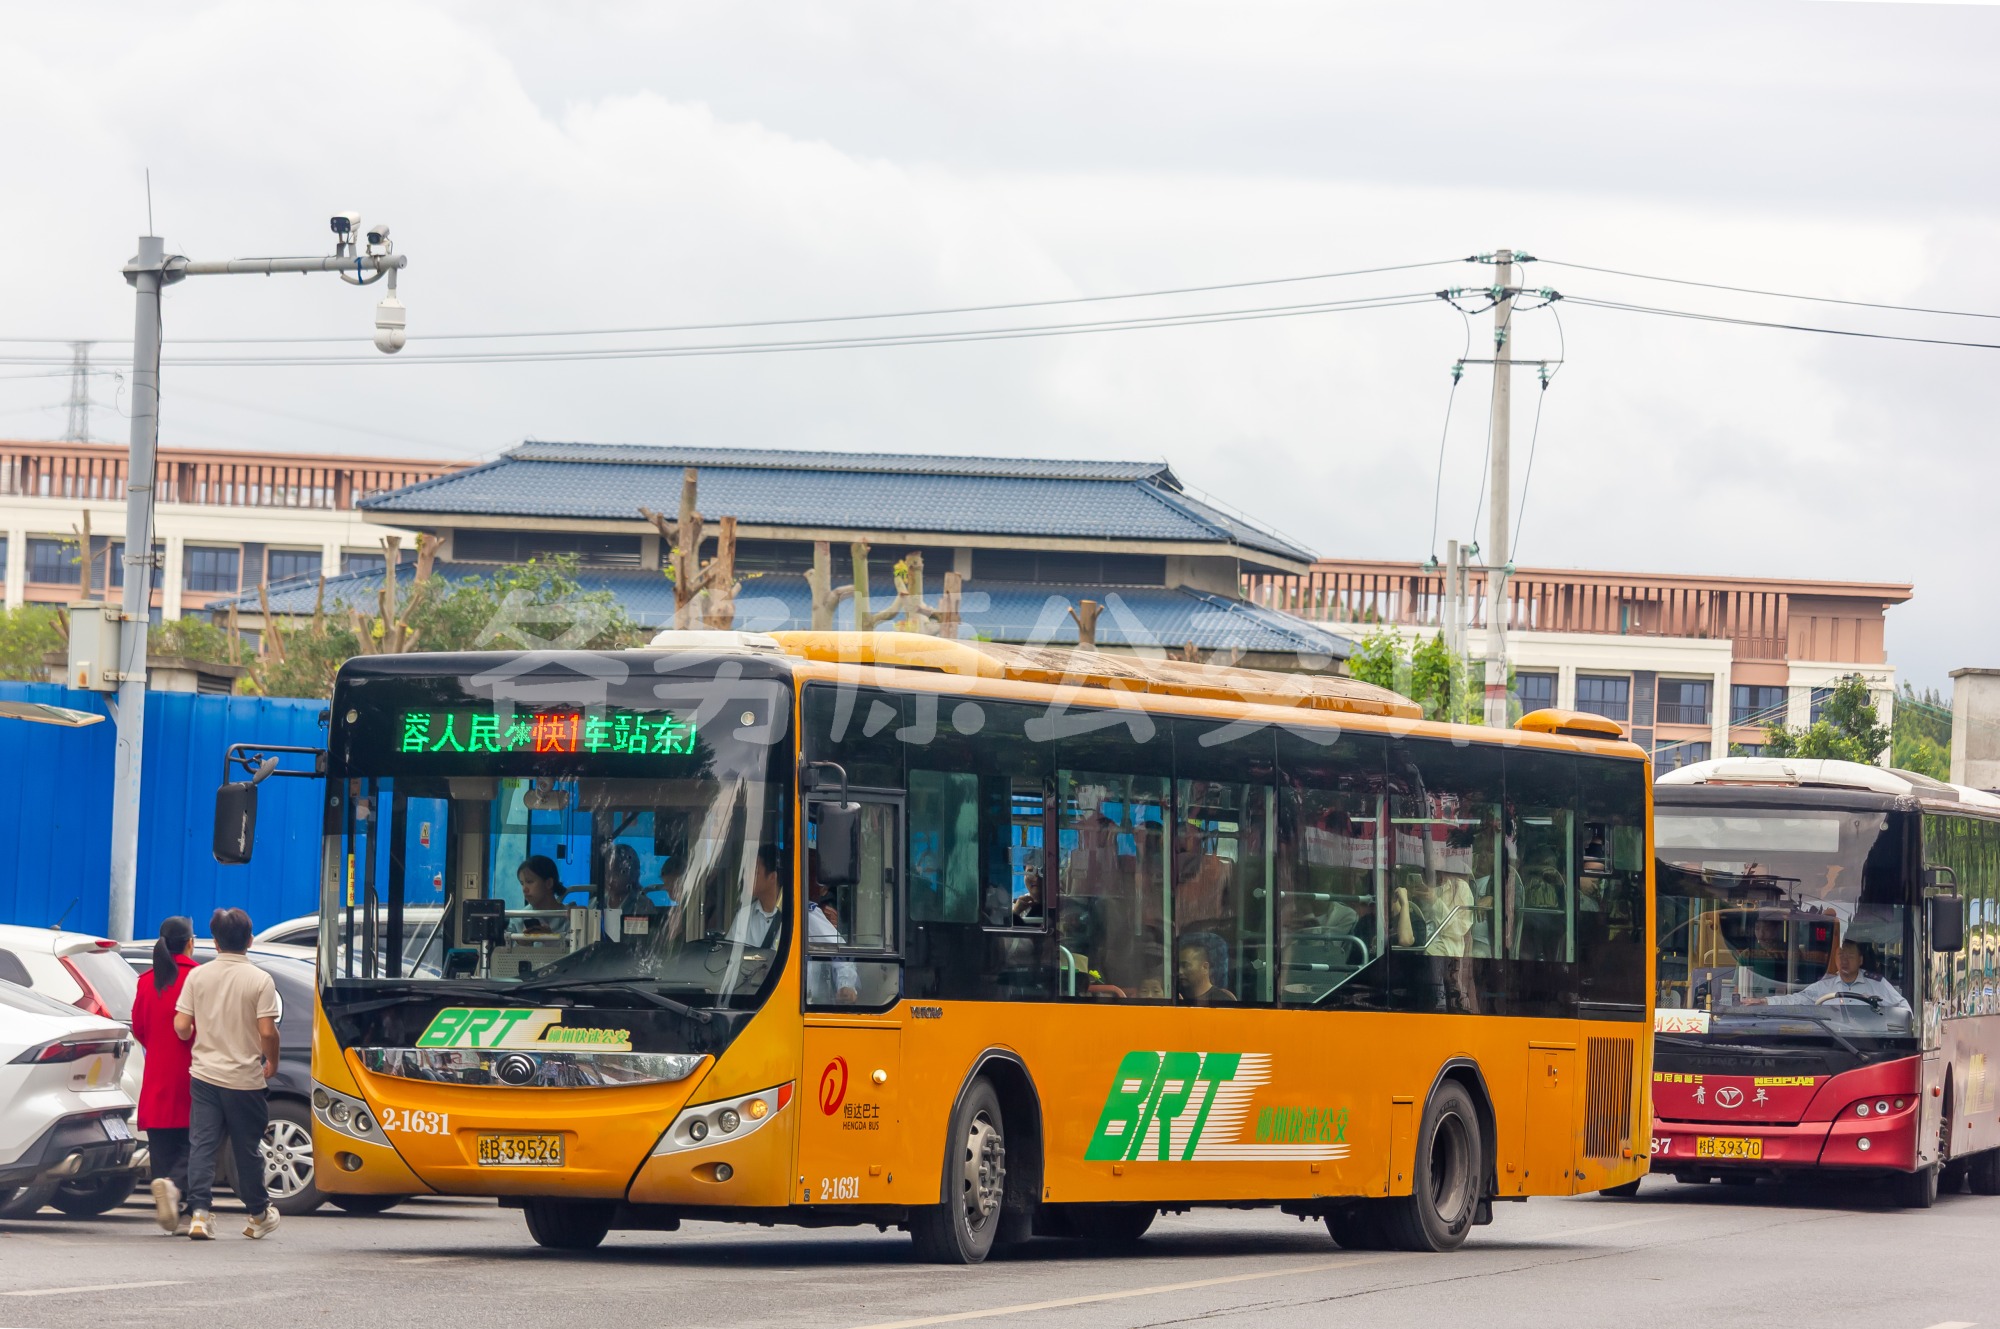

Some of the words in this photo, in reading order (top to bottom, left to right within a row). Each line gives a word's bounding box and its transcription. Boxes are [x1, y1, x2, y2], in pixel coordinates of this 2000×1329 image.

[418, 1009, 534, 1047] BRT
[548, 1029, 628, 1044] 柳州快速公交
[1754, 1076, 1814, 1087] NEOPLAN
[844, 1103, 880, 1119] 恒达巴士
[1084, 1051, 1242, 1160] BRT
[382, 1108, 451, 1136] 2-1631
[843, 1122, 866, 1130] HENGDA
[869, 1122, 879, 1130] BUS
[1255, 1106, 1350, 1142] 柳州快速公交
[1651, 1138, 1672, 1154] 87
[821, 1177, 860, 1200] 2-1631
